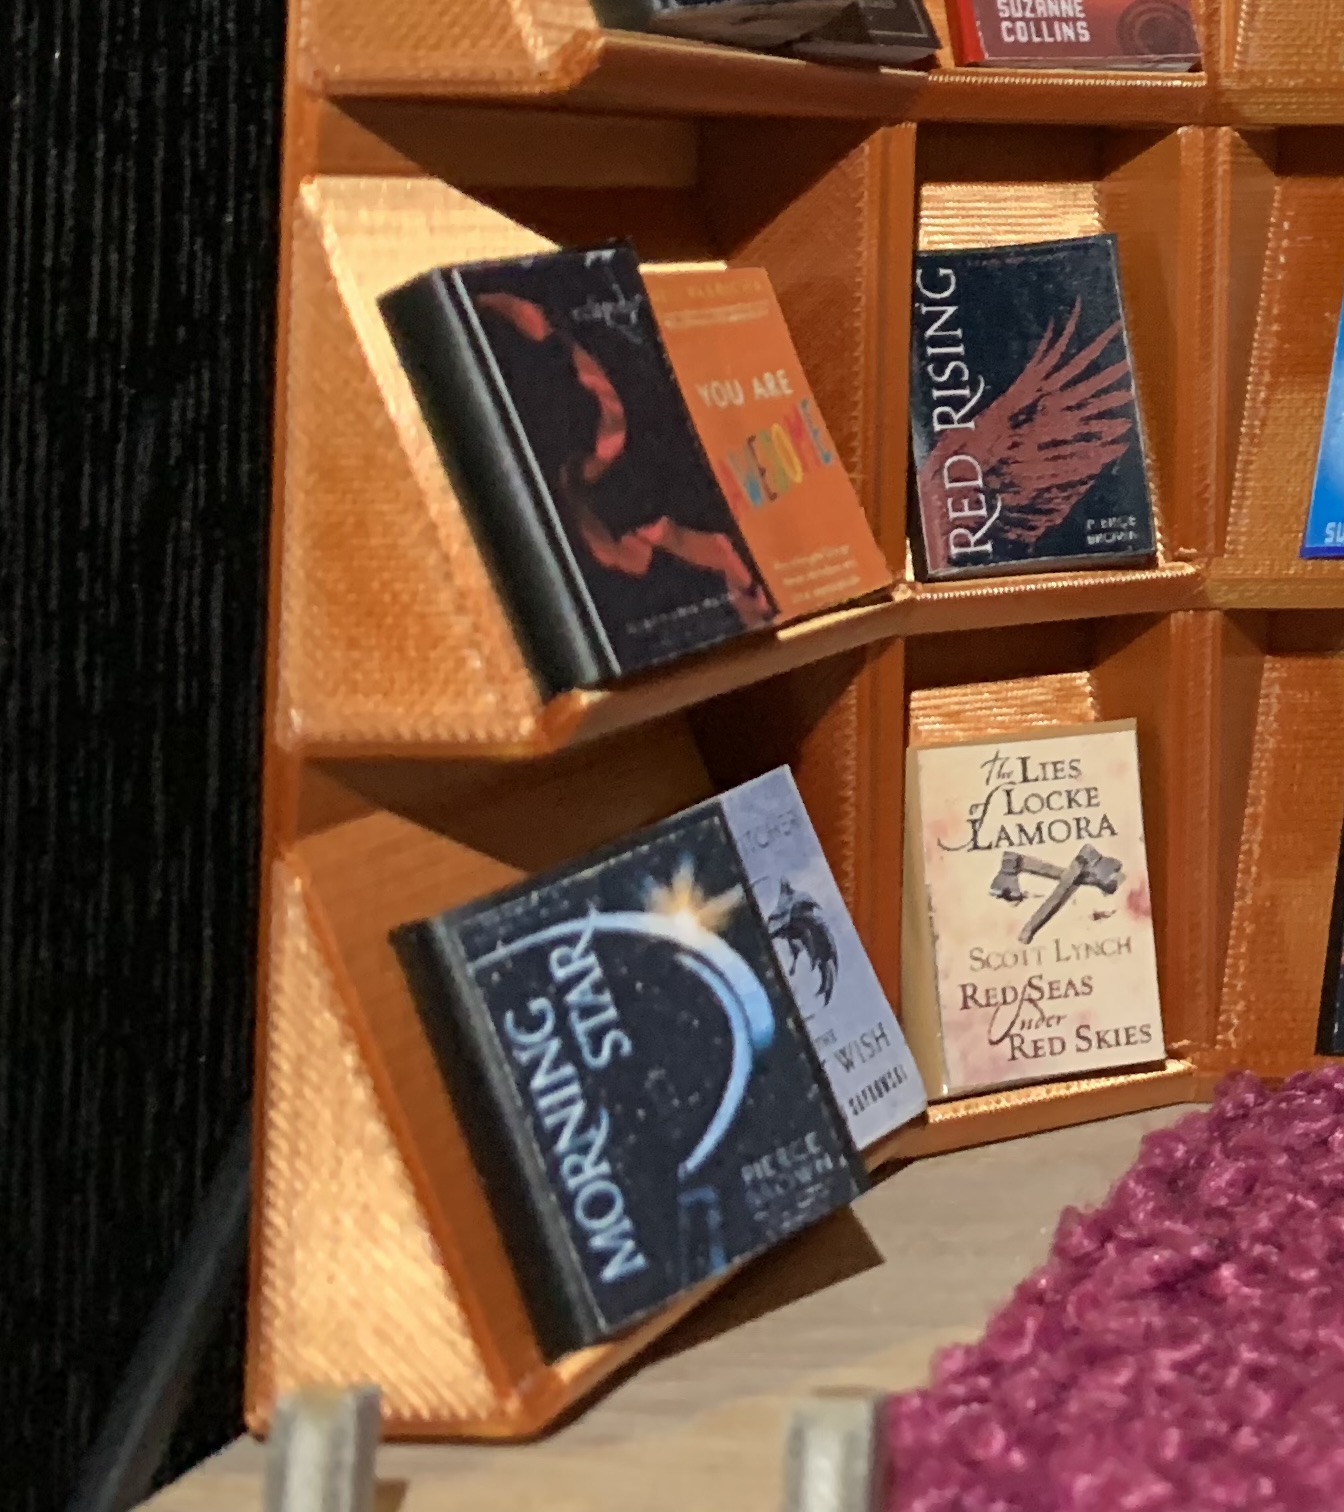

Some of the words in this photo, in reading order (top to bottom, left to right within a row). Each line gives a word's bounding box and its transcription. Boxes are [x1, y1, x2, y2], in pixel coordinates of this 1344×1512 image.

[1001, 21, 1091, 43] COLLINS
[916, 266, 985, 433] RISING
[695, 379, 745, 408] YOU
[753, 369, 794, 400] ARE
[943, 454, 1002, 560] RED
[980, 749, 1014, 786] The
[1003, 786, 1101, 816] LOCKE
[967, 814, 1118, 852] LAMORA
[969, 943, 1046, 973] SCOTT
[1055, 936, 1133, 964] LYNCH
[548, 906, 633, 1071] STAR
[959, 982, 1027, 1011] RED
[1026, 974, 1094, 1004] SEAS
[833, 1021, 891, 1073] WISH
[1007, 1032, 1067, 1063] RED
[1076, 1023, 1153, 1054] SKIES
[504, 996, 649, 1284] MORNING
